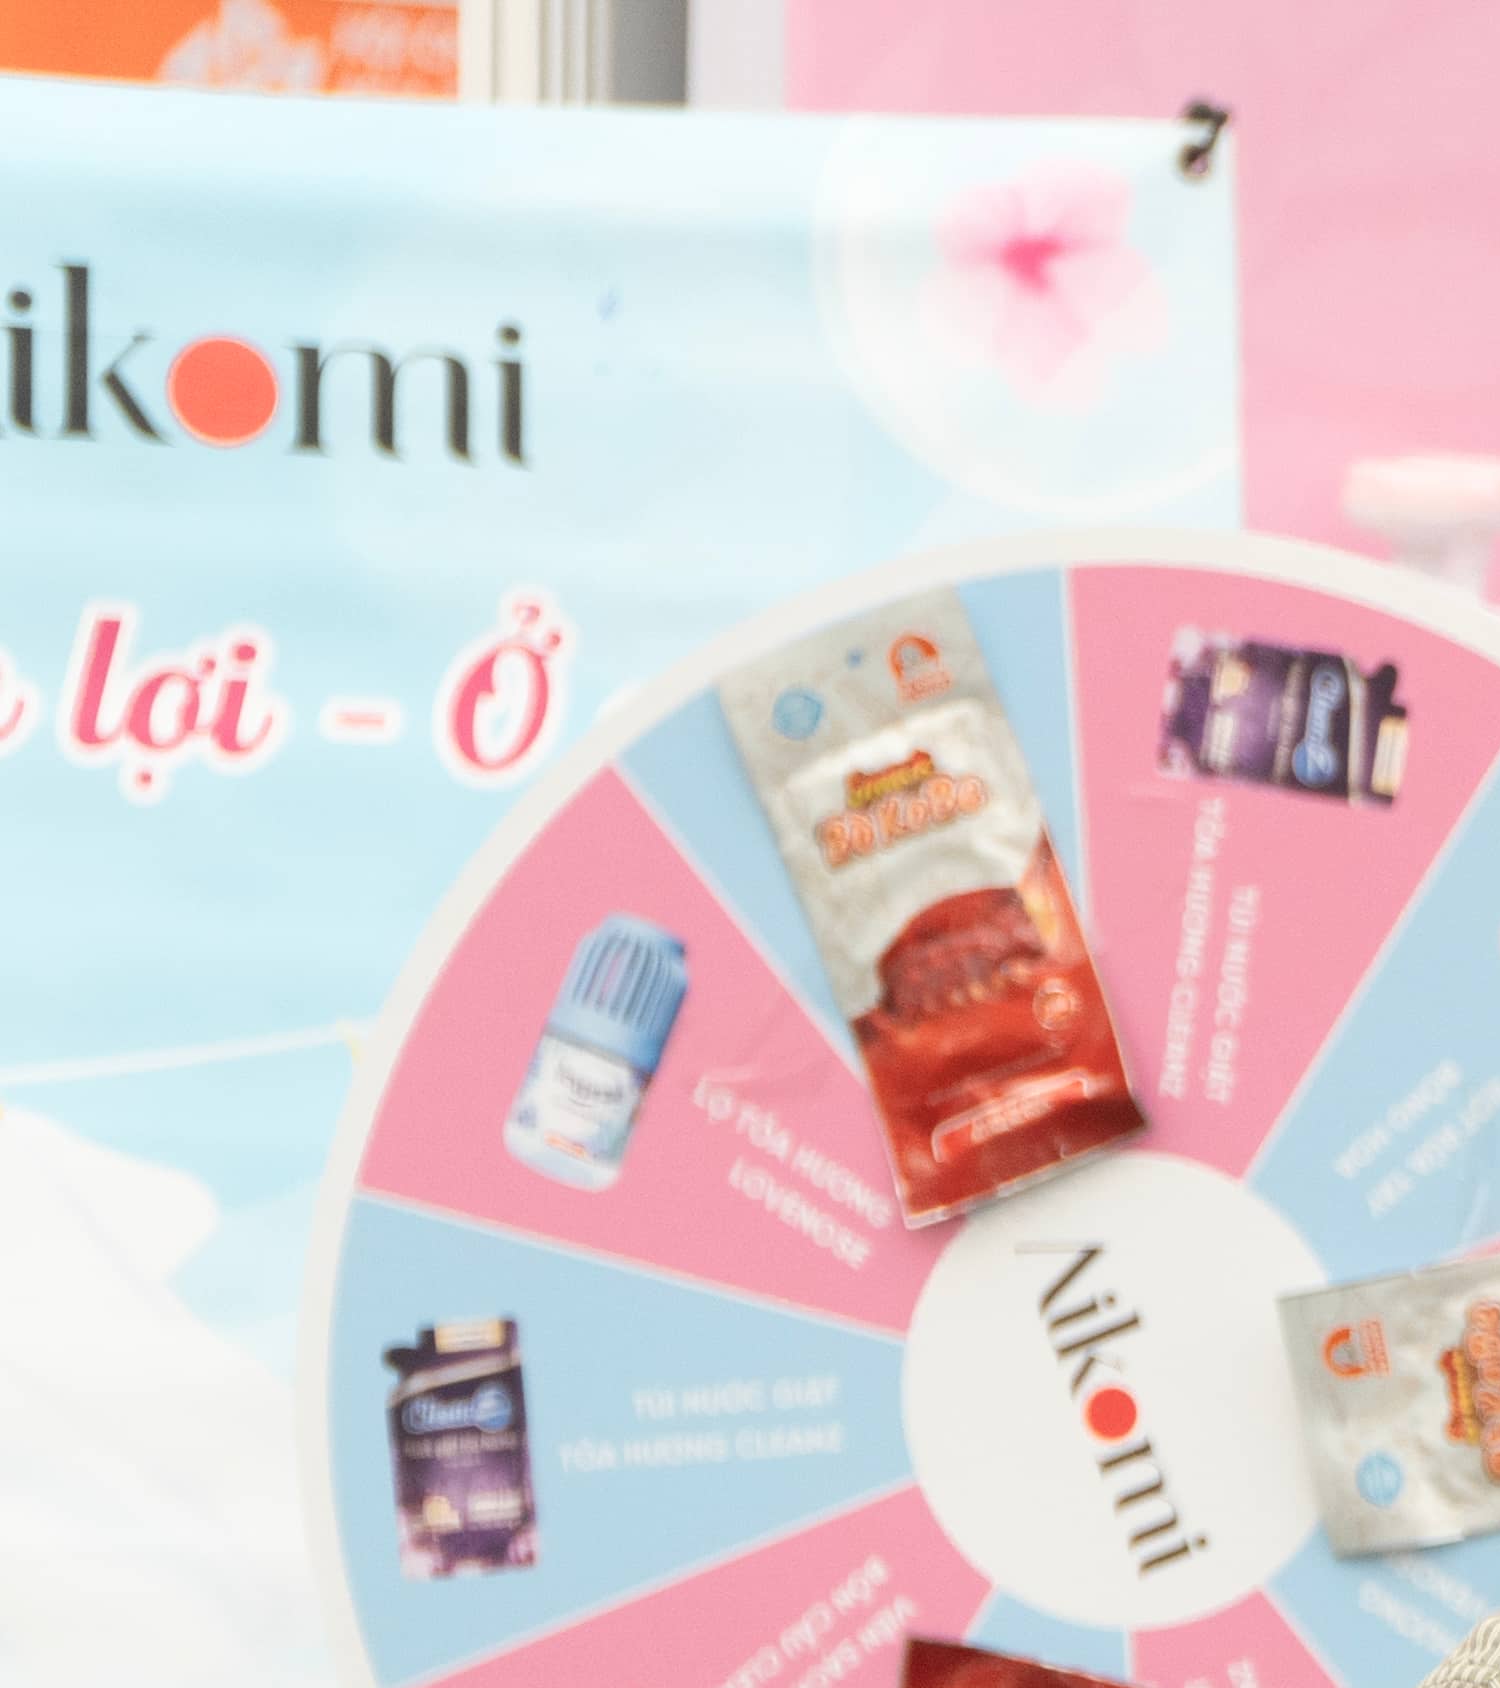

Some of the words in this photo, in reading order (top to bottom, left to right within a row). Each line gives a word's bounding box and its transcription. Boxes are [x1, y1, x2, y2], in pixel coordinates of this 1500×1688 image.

[0, 258, 531, 471] ikomi
[70, 618, 274, 786] lợi
[449, 600, 562, 774] Ở
[1014, 1240, 1211, 1580] Aikomi
